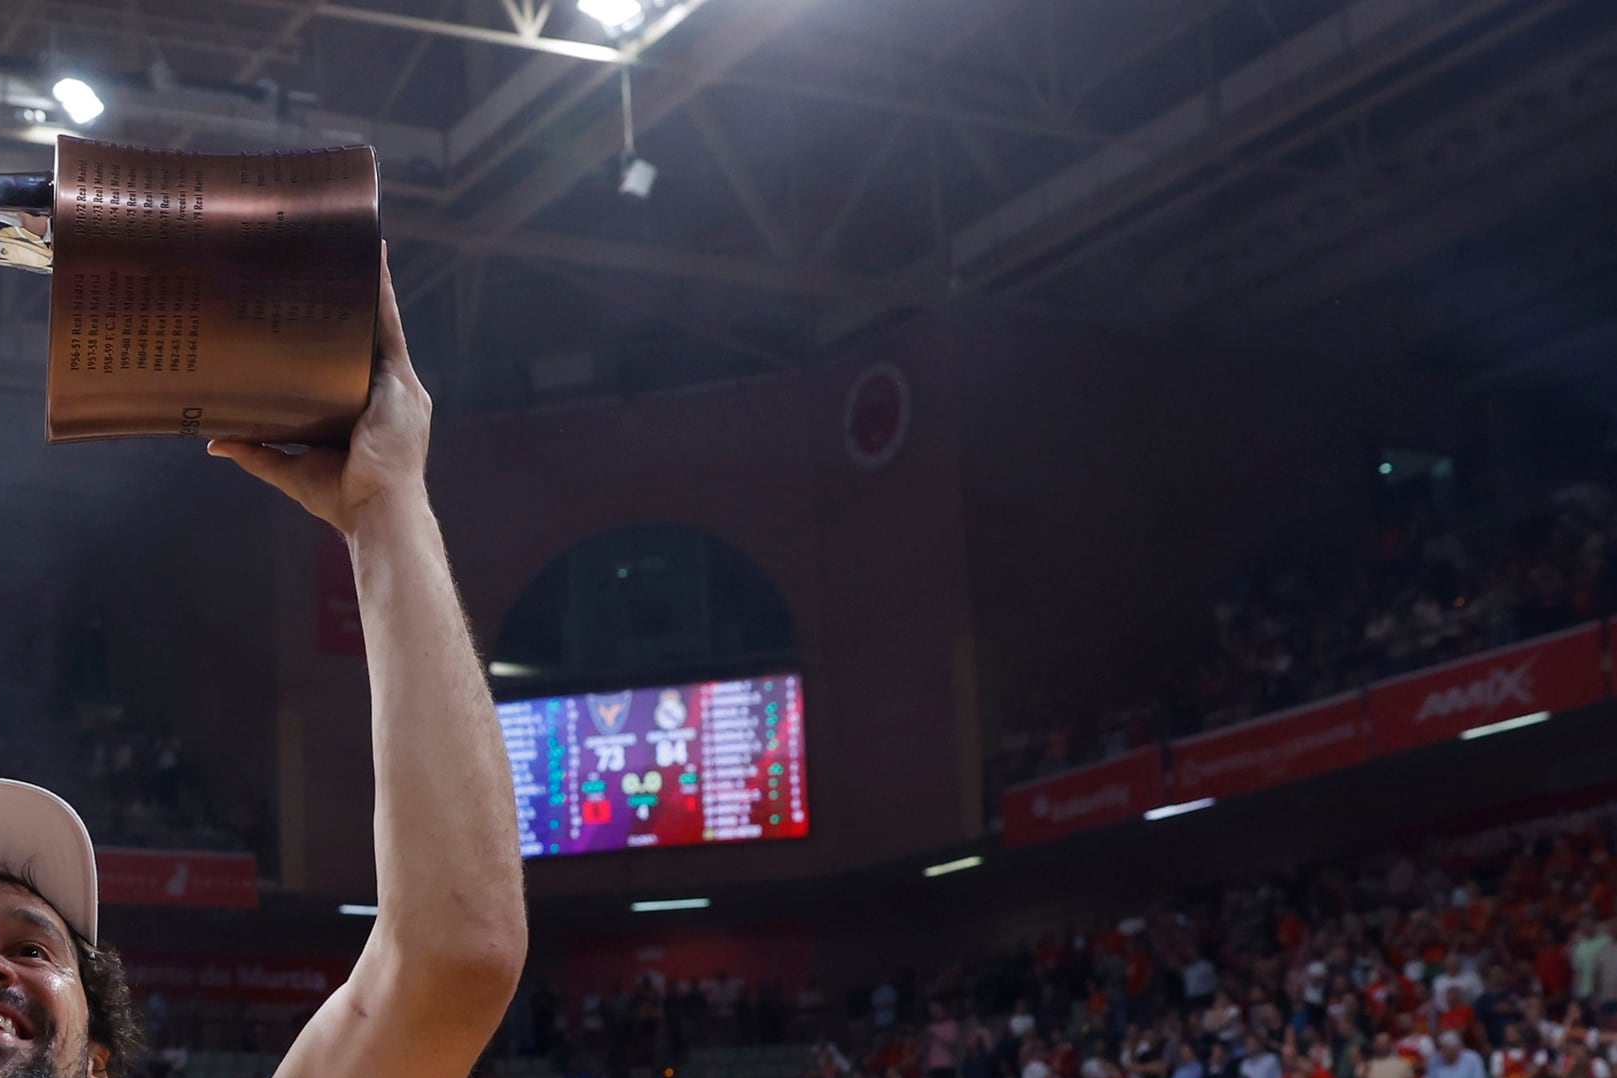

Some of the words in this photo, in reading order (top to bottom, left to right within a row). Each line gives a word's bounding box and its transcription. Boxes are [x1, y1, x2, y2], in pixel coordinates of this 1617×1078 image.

[76, 185, 86, 202] Real
[93, 186, 103, 203] Real
[110, 188, 120, 205] Real
[127, 190, 136, 207] Real
[143, 191, 153, 208] Real
[160, 192, 169, 209] Real
[194, 194, 203, 210] Real
[72, 314, 82, 335] Real
[88, 314, 98, 336] Real
[121, 314, 133, 335] Real
[138, 315, 149, 336] Real
[156, 315, 166, 336] Real
[172, 315, 183, 336] Real
[189, 316, 199, 337] Real
[71, 338, 82, 371] 1956-57
[87, 339, 98, 370] 1957-58
[103, 343, 113, 374] 1958-59
[120, 338, 131, 369] 1959-60
